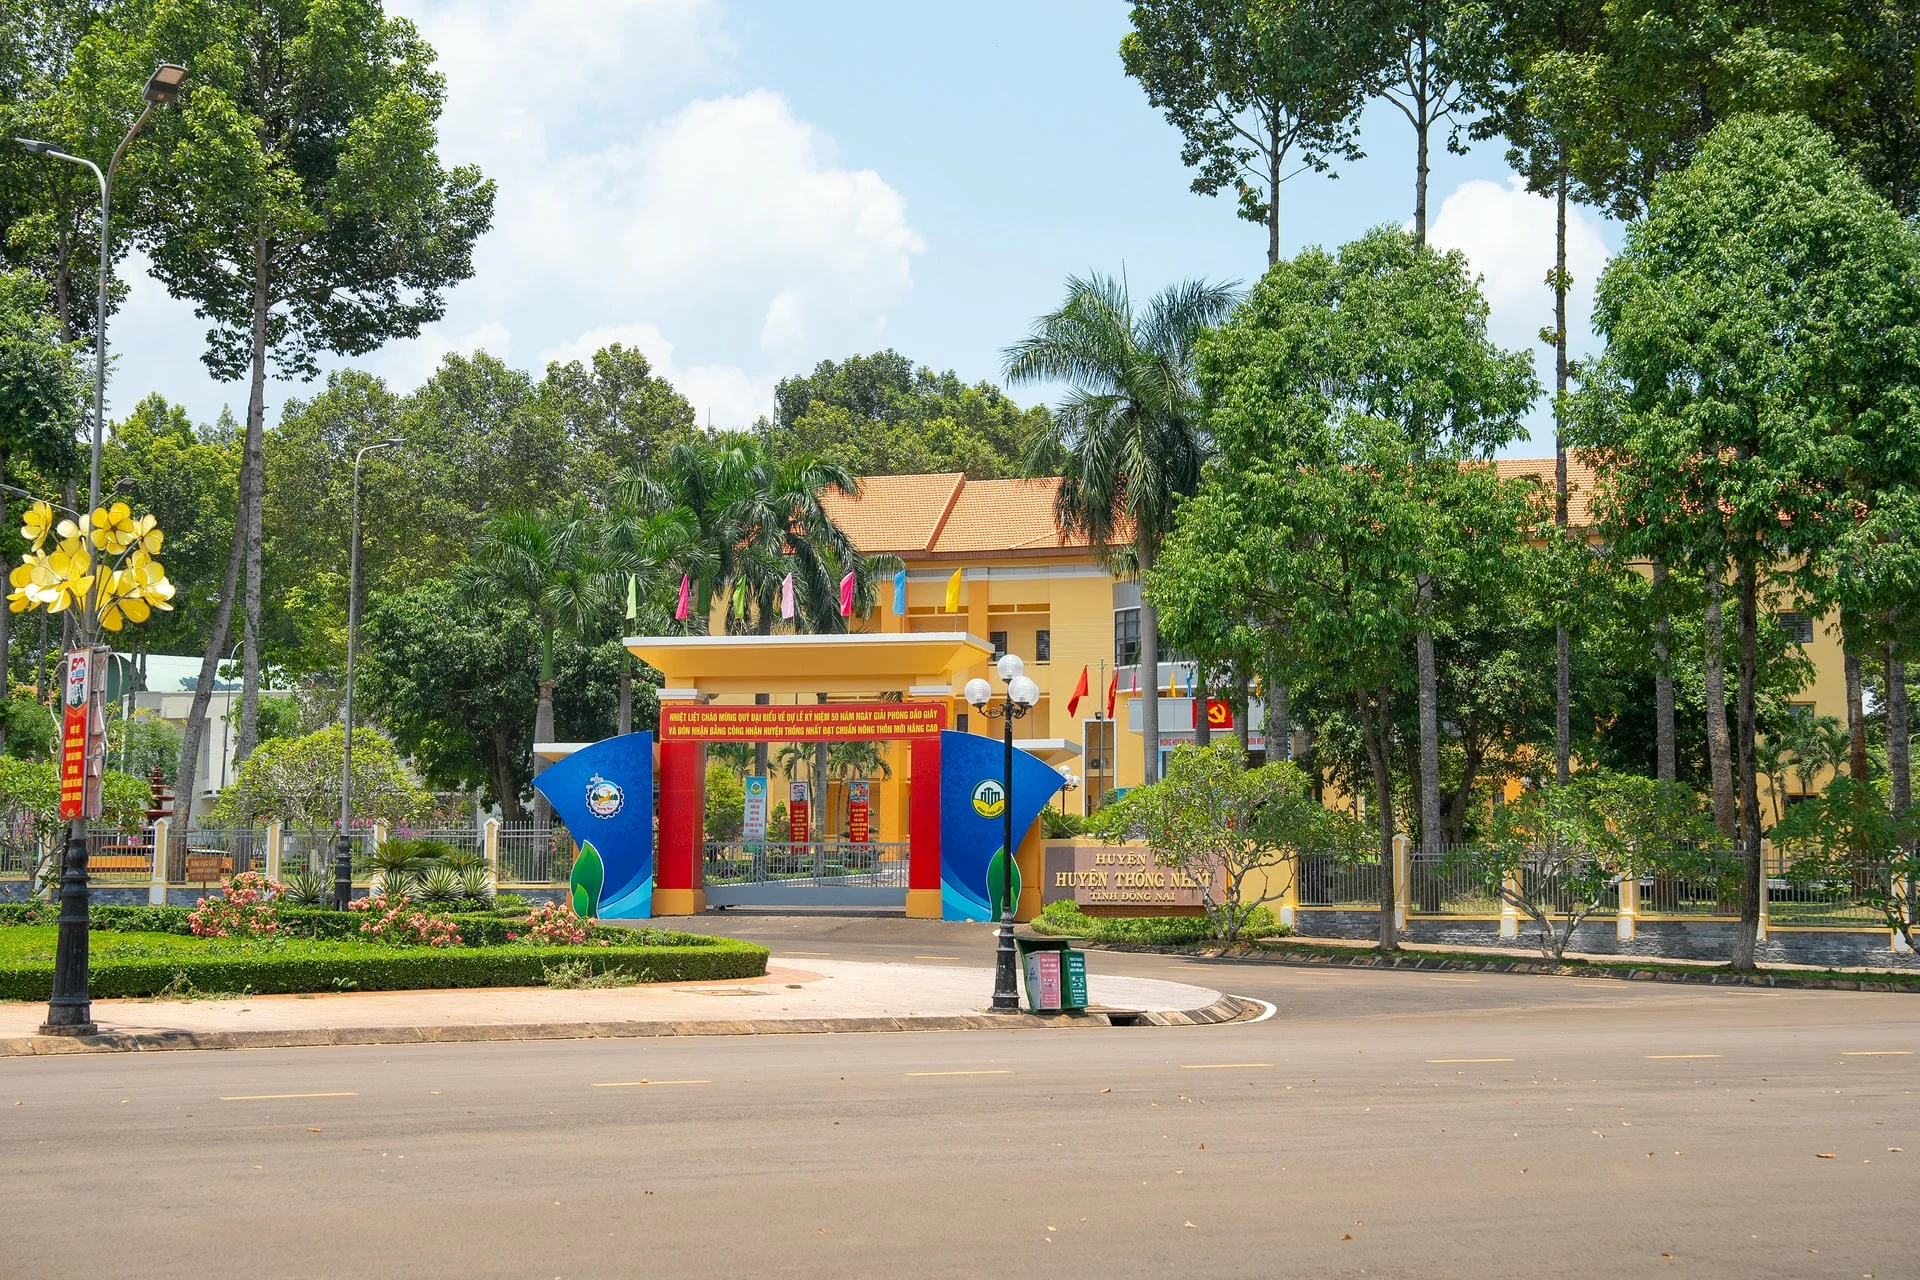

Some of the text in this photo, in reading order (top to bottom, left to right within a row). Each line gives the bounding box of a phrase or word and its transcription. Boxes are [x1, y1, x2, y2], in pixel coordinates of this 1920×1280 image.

[669, 711, 687, 723] NHIỆT
[687, 711, 700, 723] LIỆT
[701, 711, 718, 722] CHÀO
[718, 711, 737, 722] MỪNG
[751, 711, 762, 724] ĐẠI
[786, 711, 796, 723] DỰ
[813, 711, 830, 723] NIỆM
[831, 712, 839, 721] 50
[840, 711, 855, 721] NĂM
[855, 710, 873, 721] NGÀY
[873, 709, 886, 721] GIẢI
[887, 709, 908, 720] PHÓNG
[668, 725, 677, 736] VÀ
[677, 725, 691, 736] ĐÓN
[691, 725, 709, 737] NHẬN
[727, 725, 744, 736] CÔNG
[745, 725, 762, 737] NHẬN
[763, 725, 784, 737] HUYỆN
[784, 724, 805, 736] THỐNG
[805, 724, 822, 735] NHẤT
[822, 725, 835, 737] ĐẠT
[835, 723, 857, 735] CHUẨN
[857, 724, 876, 735] NÔNG
[876, 723, 893, 734] THÔN
[893, 723, 906, 734] MỚI
[907, 723, 925, 734] NÂNG
[925, 724, 938, 733] CAO
[1095, 852, 1147, 868] HUYỆN
[1055, 868, 1109, 890] HUYỆN
[1114, 866, 1165, 888] THỐNG
[1155, 892, 1176, 900] NAI
